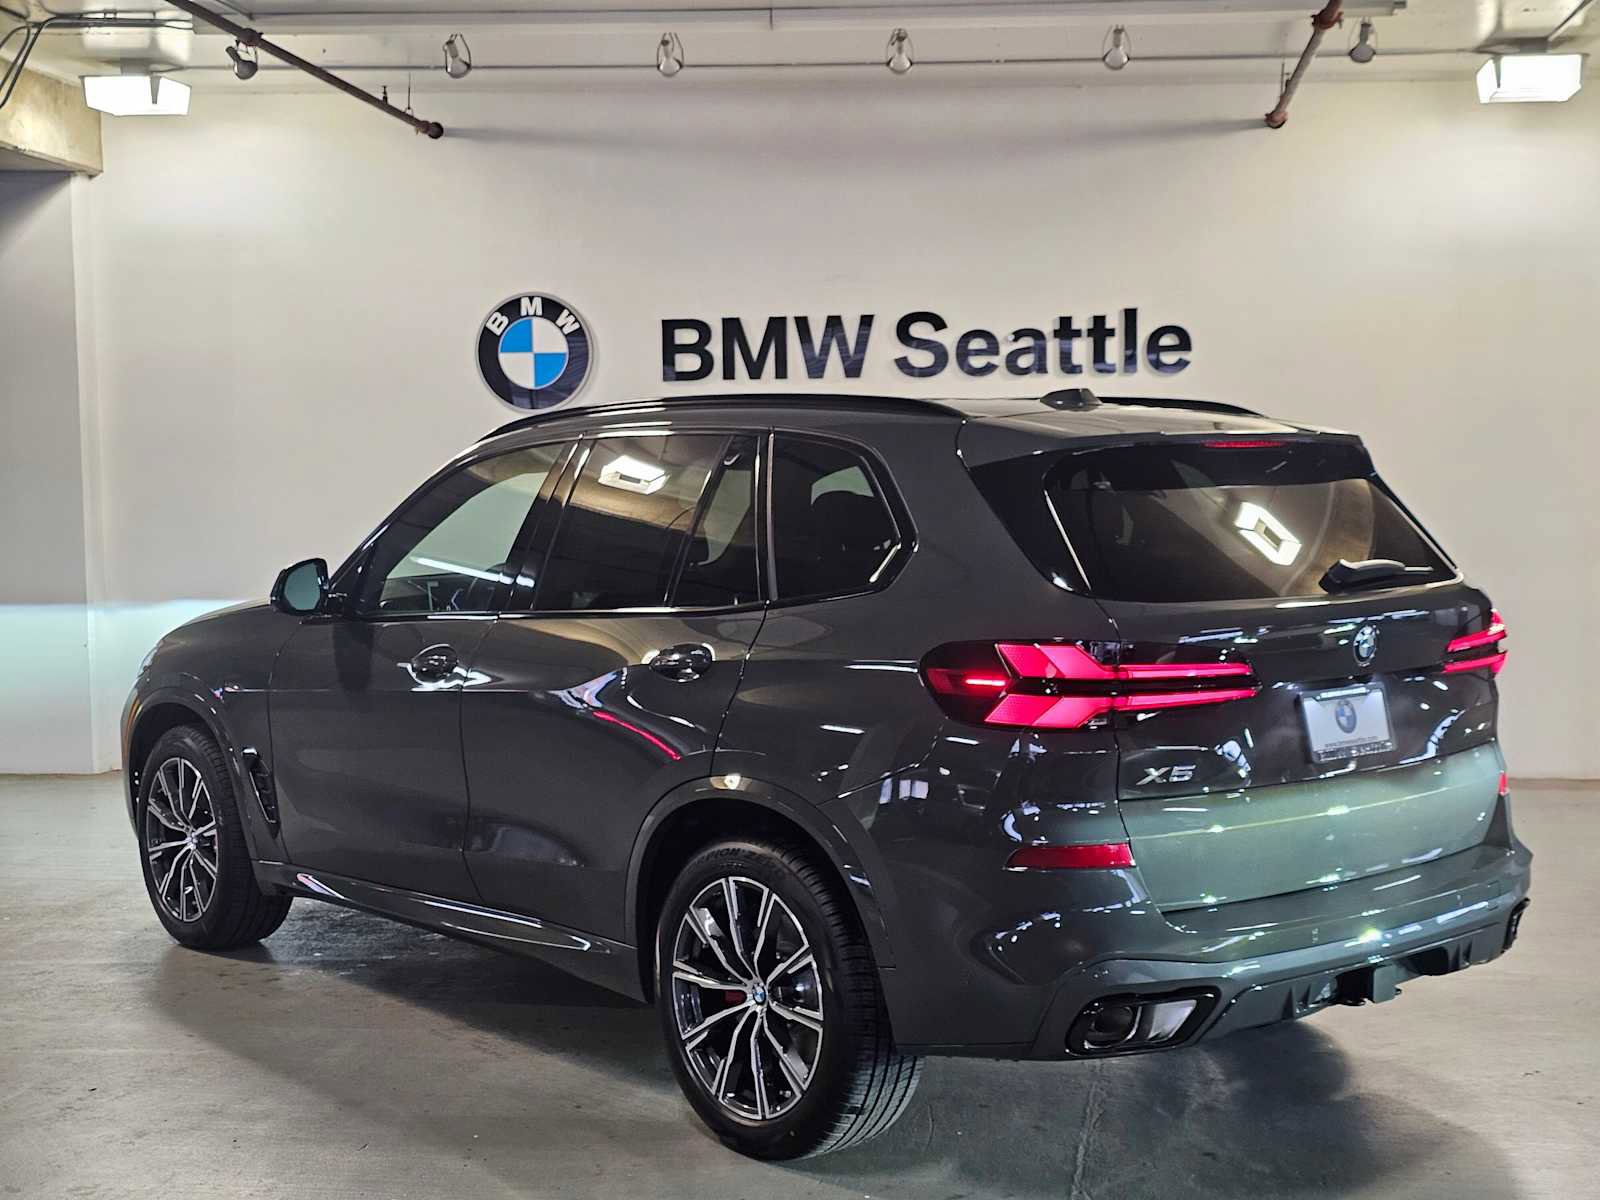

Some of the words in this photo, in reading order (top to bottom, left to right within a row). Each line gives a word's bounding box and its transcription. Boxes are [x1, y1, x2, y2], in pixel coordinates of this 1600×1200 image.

[485, 296, 581, 336] BMW
[661, 314, 875, 382] BMW
[894, 308, 1193, 378] Seattle
[1135, 764, 1197, 786] X5
